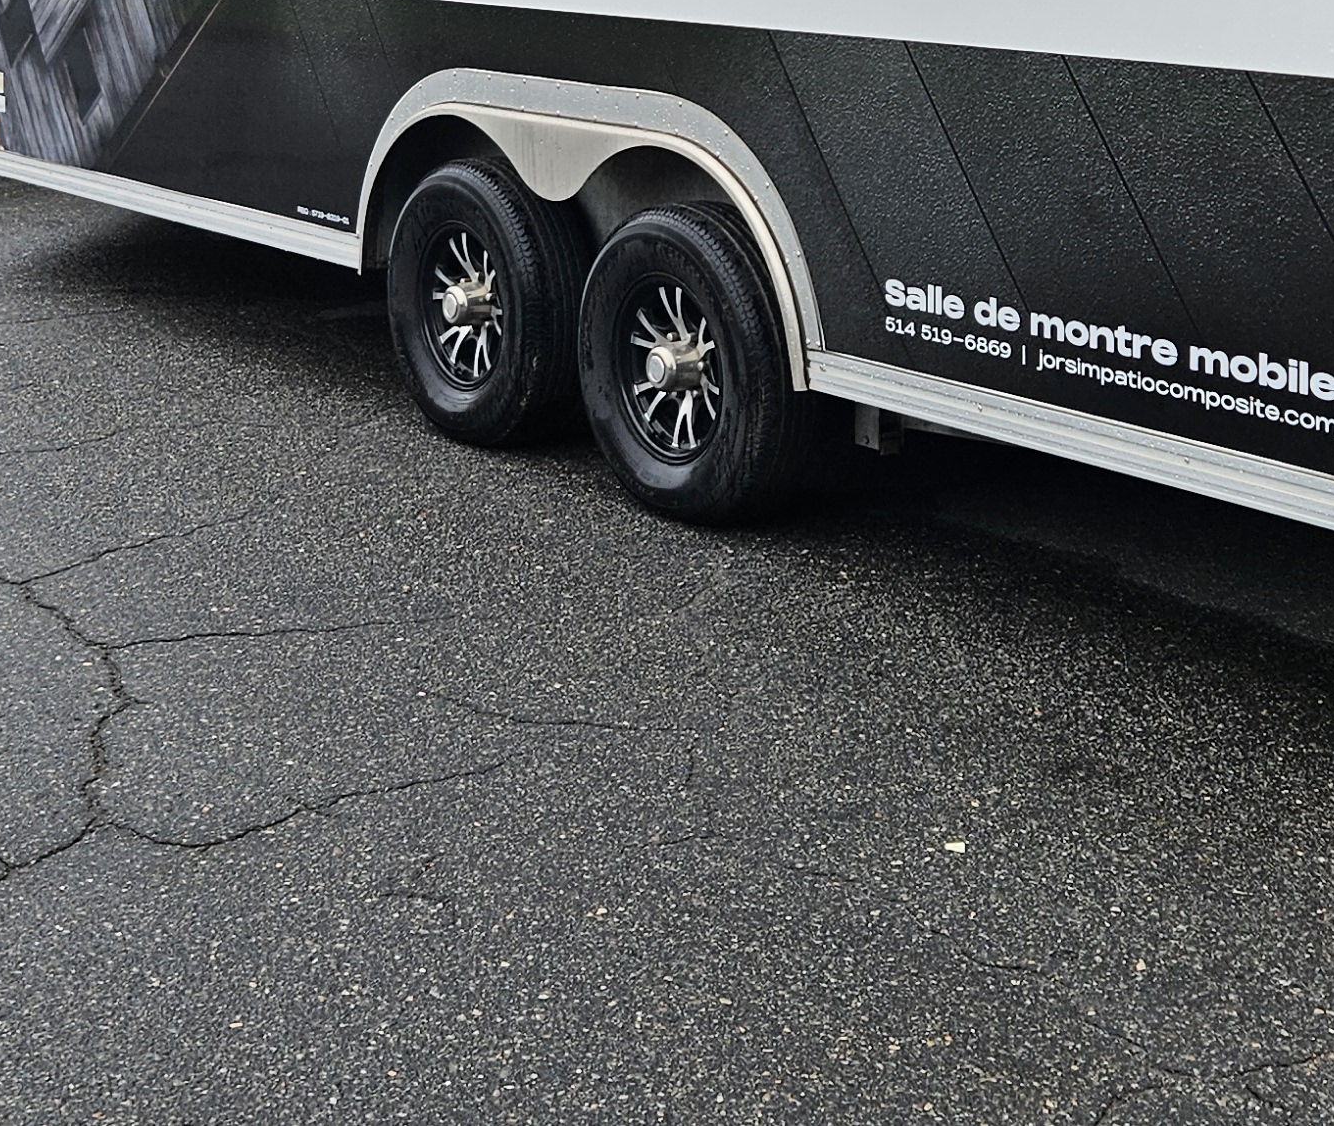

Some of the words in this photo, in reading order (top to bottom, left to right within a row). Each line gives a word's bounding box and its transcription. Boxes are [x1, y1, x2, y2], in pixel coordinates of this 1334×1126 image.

[885, 278, 965, 320] Salle
[974, 296, 1020, 332] de
[1030, 311, 1178, 366] montre
[885, 316, 916, 337] 514
[921, 324, 1012, 359] 519-6869
